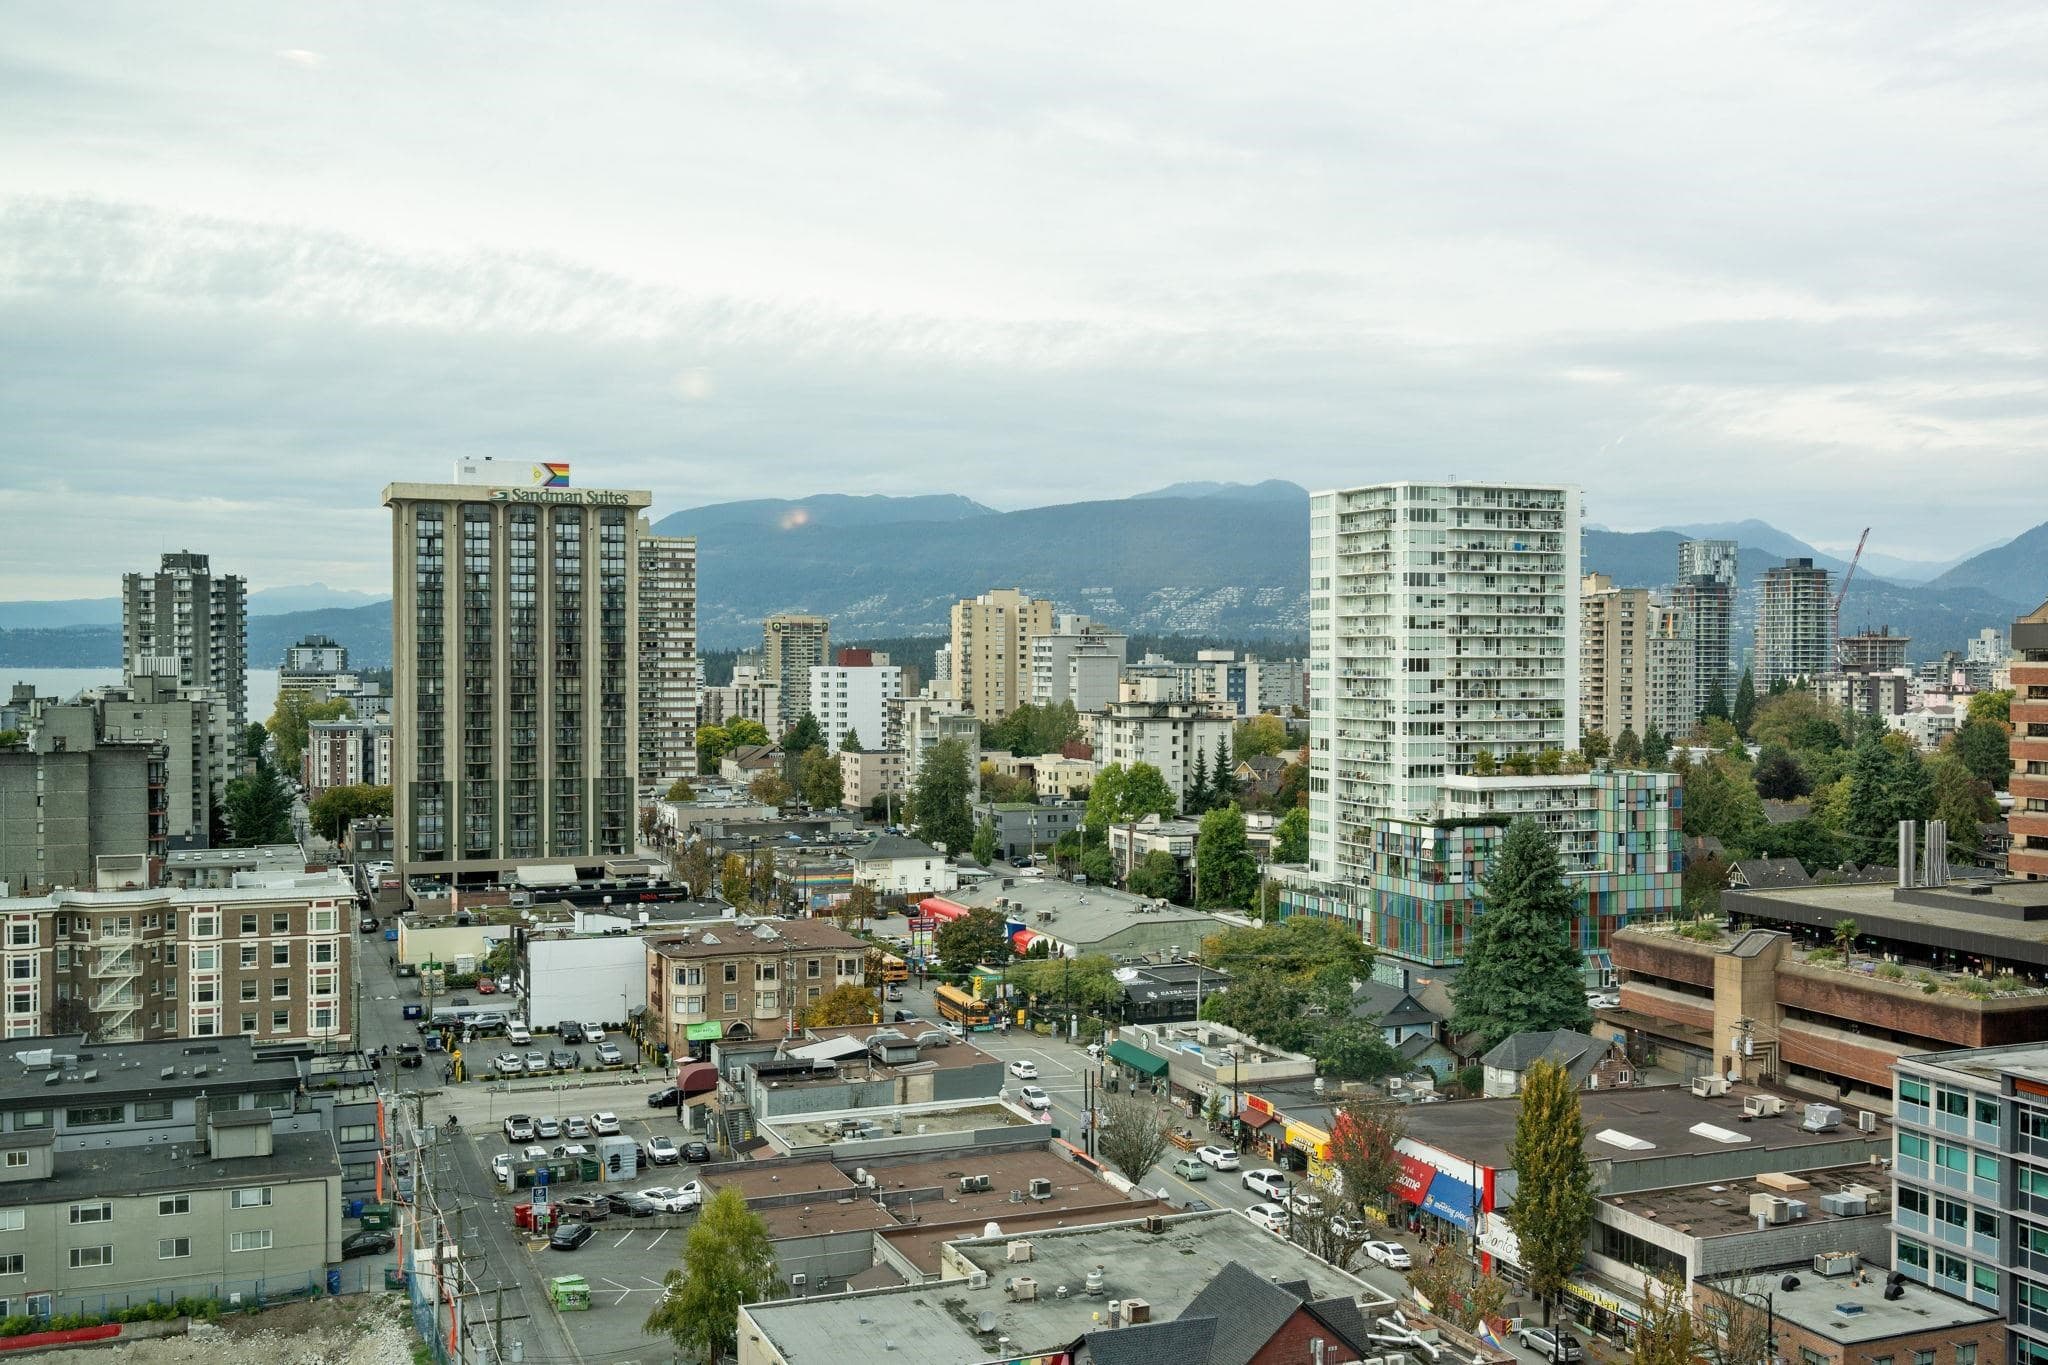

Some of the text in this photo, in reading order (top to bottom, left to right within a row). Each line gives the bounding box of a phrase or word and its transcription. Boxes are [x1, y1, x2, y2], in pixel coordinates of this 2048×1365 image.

[512, 488, 629, 505] Sandman Suites
[1434, 1201, 1456, 1218] meeting
[1561, 1279, 1620, 1313] Banana Leaf
